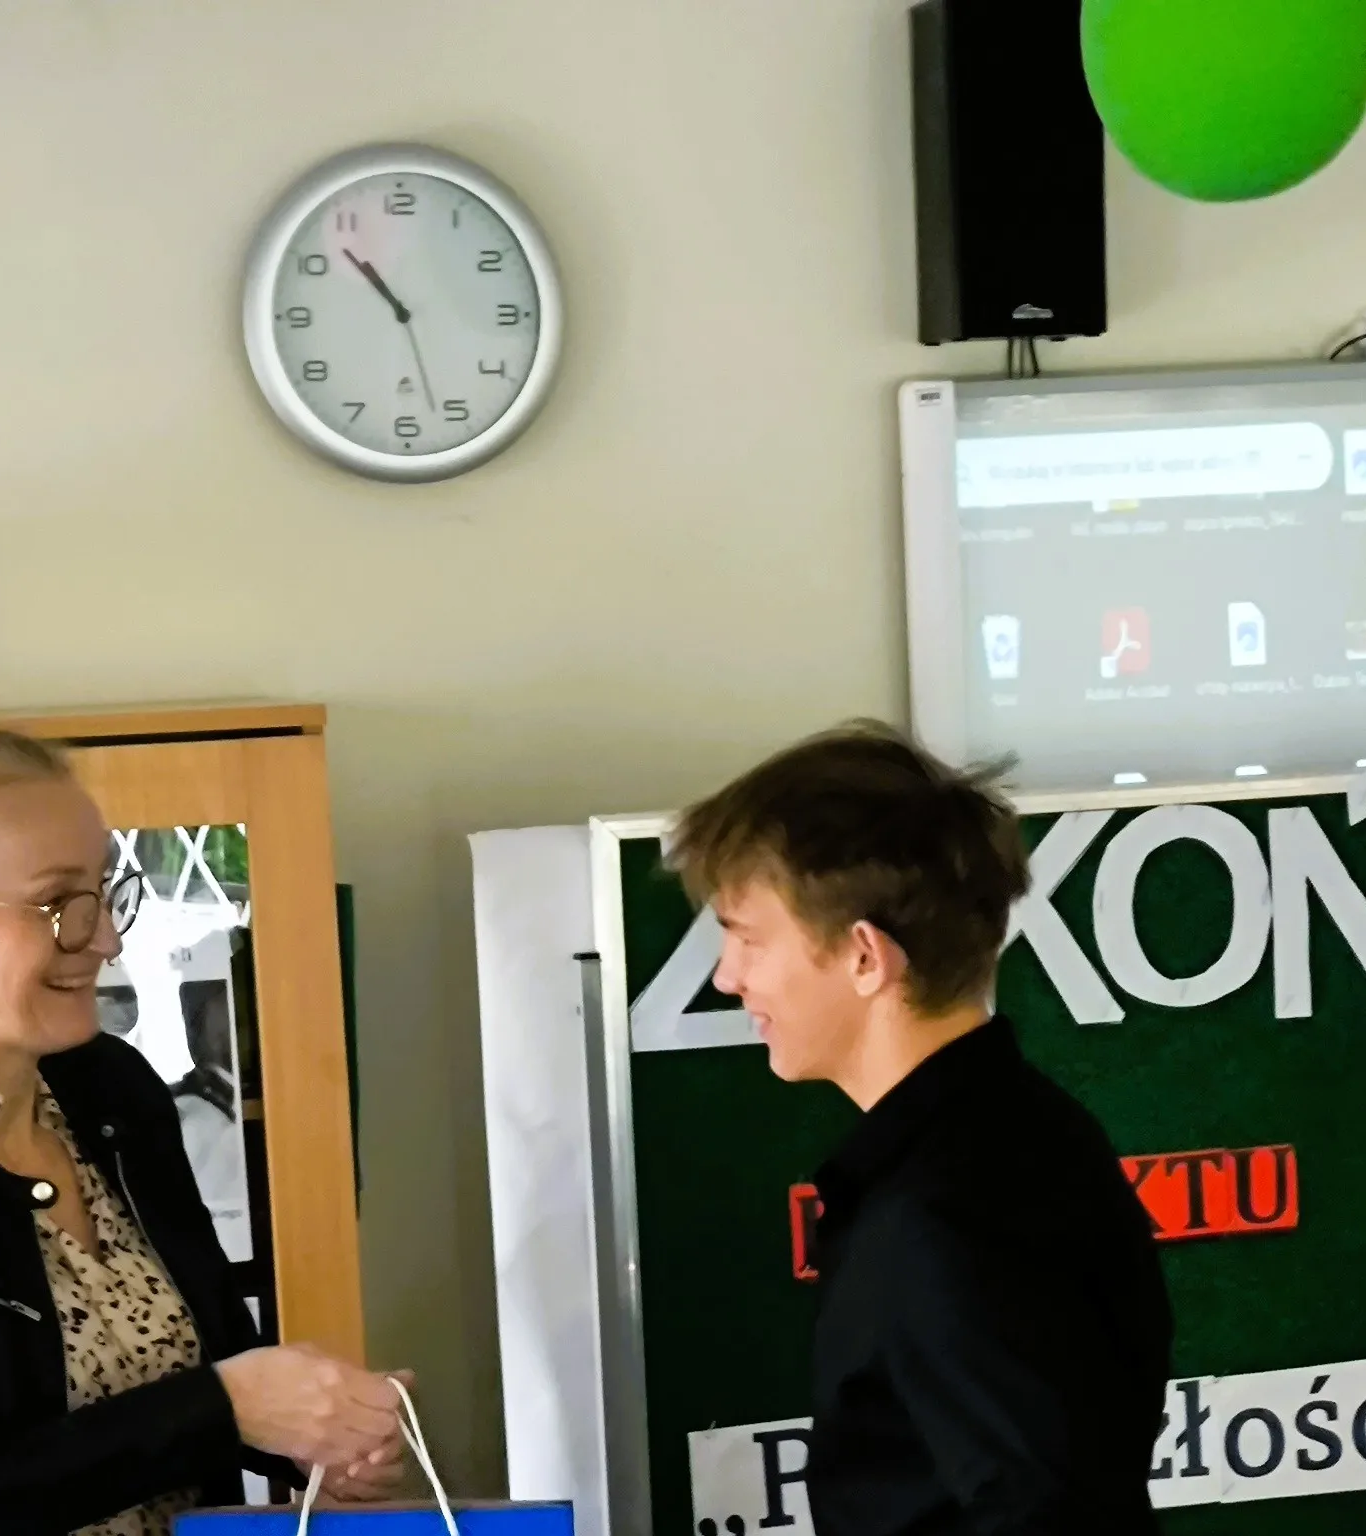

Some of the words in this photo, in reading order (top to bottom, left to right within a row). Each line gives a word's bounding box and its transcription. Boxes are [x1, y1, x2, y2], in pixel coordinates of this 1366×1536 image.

[384, 193, 416, 215] 12
[297, 254, 328, 276] 10
[477, 250, 502, 272] 2
[286, 306, 311, 328] 9
[497, 304, 519, 326] 3
[302, 360, 328, 381] 8
[478, 360, 504, 378] 4
[342, 402, 365, 422] 7
[443, 400, 469, 422] 5
[394, 416, 420, 437] 6
